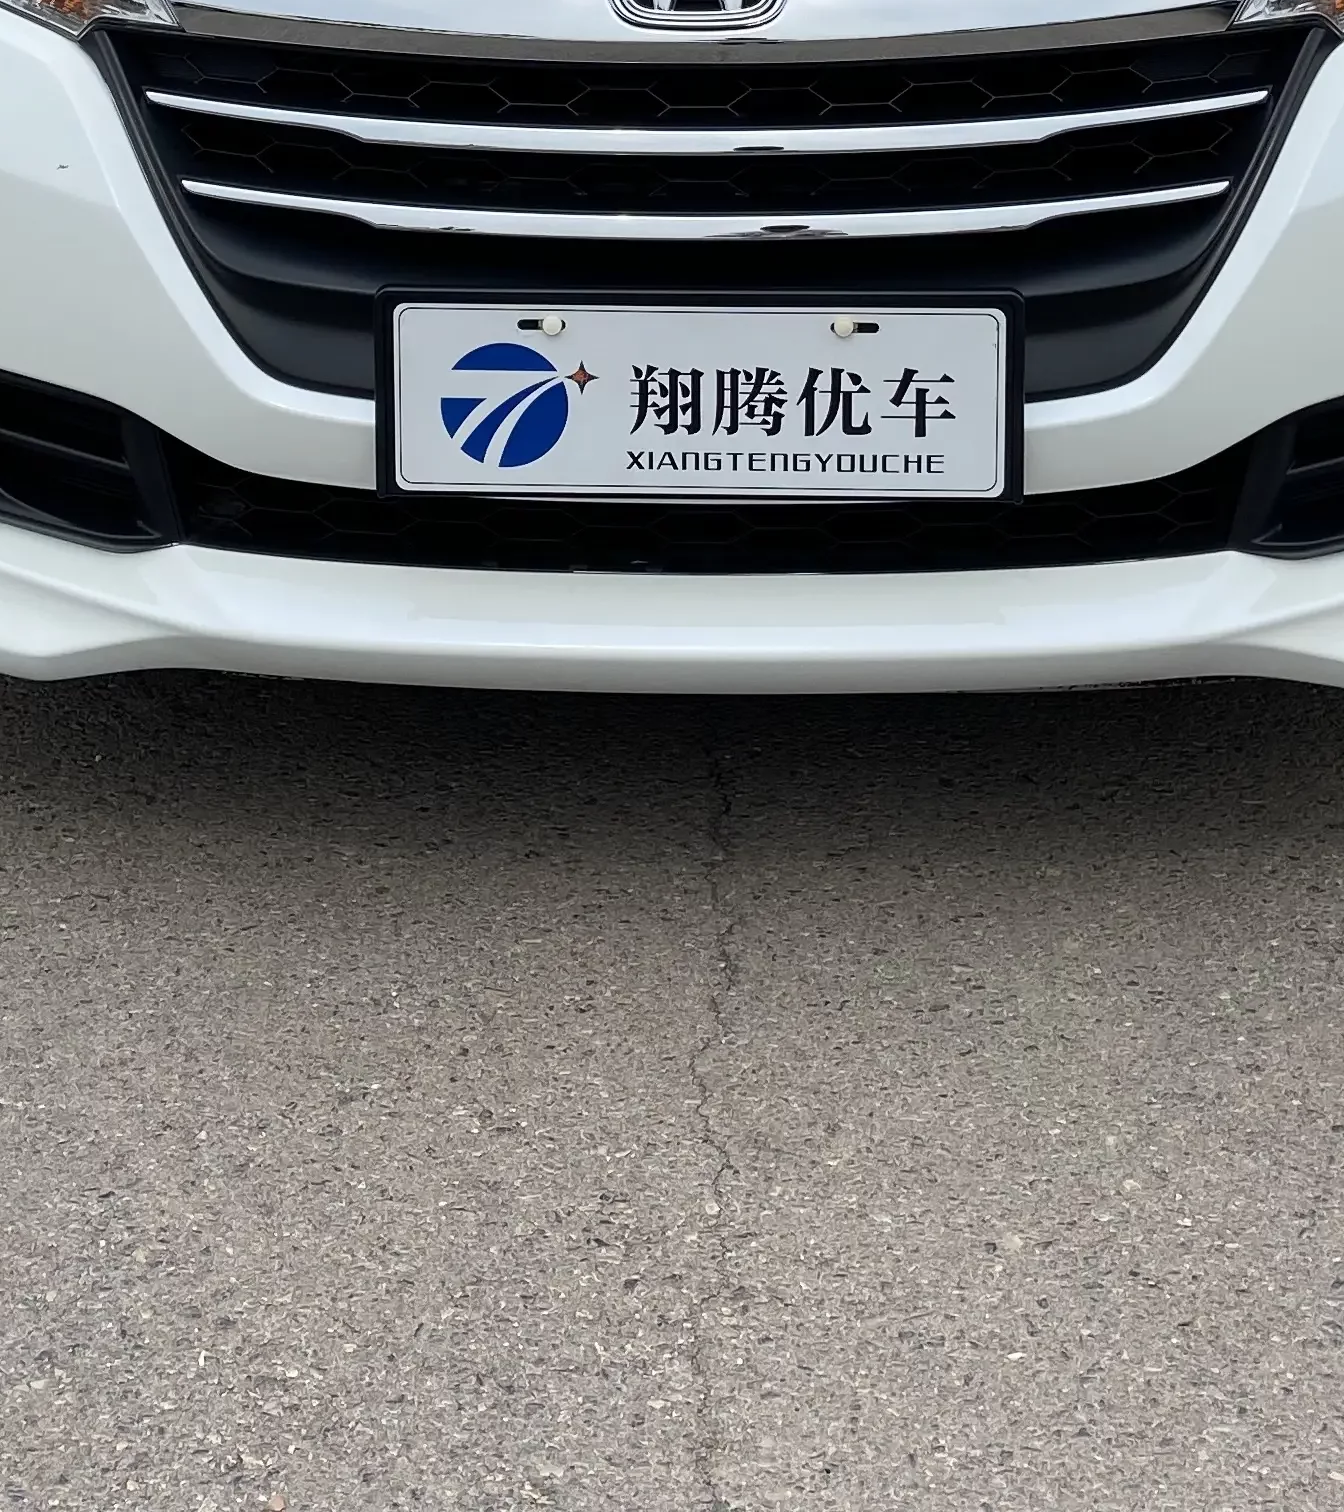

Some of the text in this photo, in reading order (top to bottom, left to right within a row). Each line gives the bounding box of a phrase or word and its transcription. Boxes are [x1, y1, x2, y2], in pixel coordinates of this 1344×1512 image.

[628, 363, 957, 439] 翔腾优车
[626, 450, 945, 475] XIANGTENGYOUCHE
